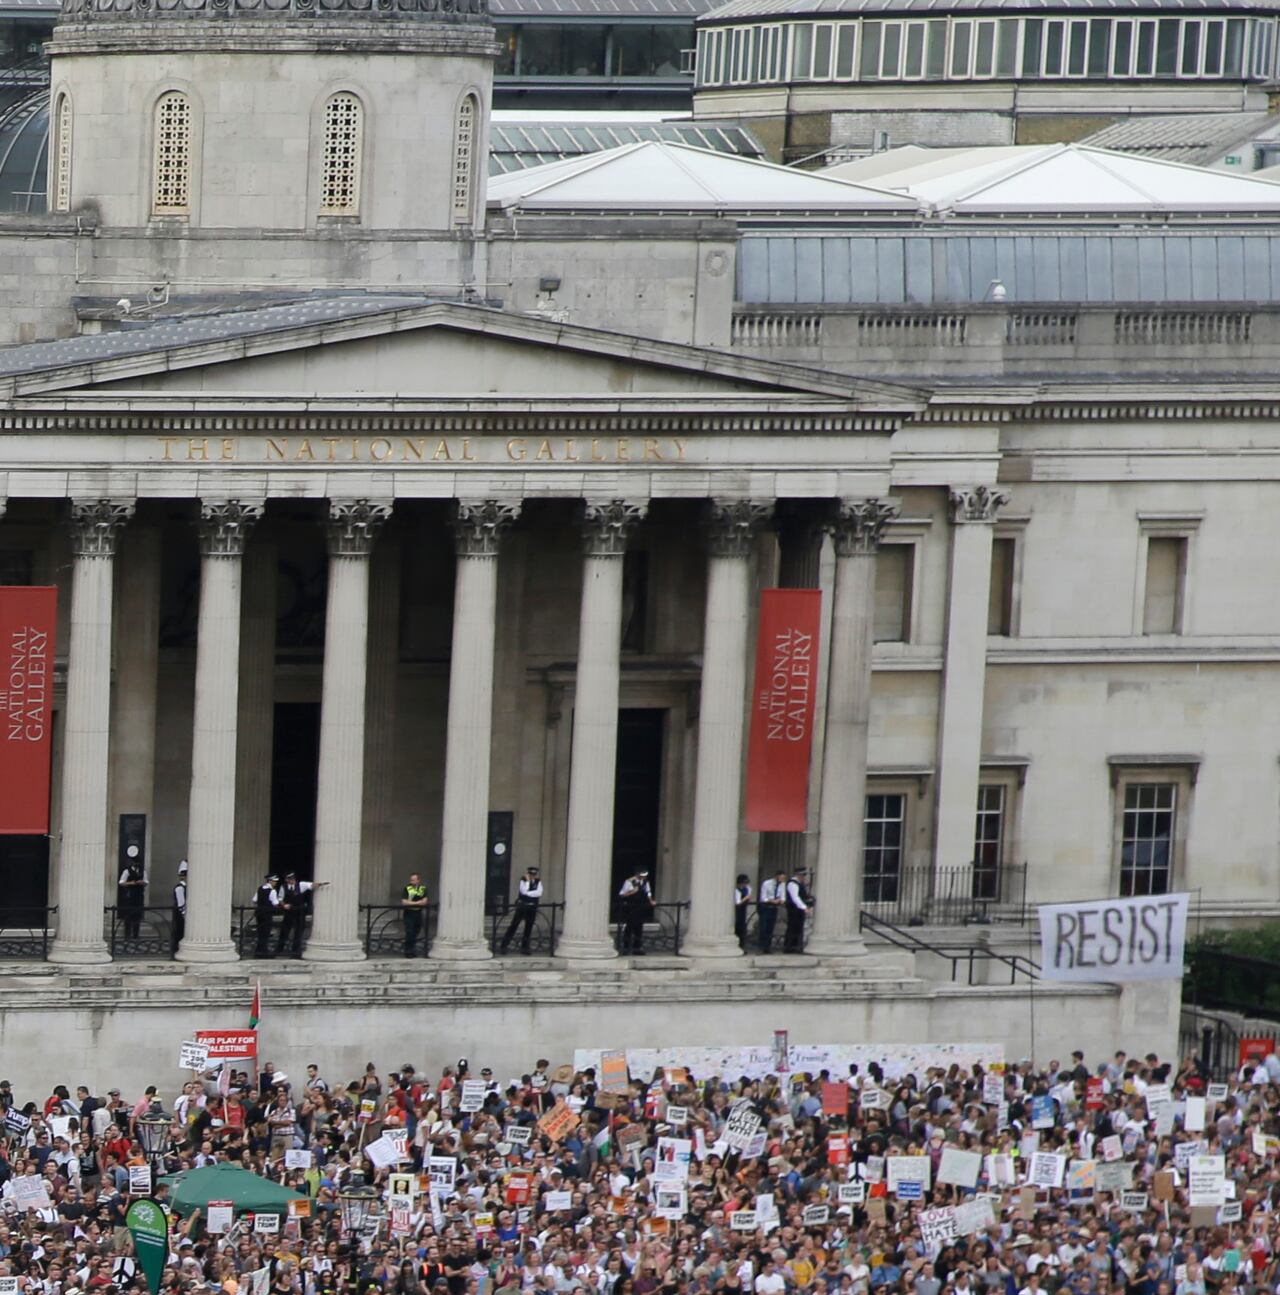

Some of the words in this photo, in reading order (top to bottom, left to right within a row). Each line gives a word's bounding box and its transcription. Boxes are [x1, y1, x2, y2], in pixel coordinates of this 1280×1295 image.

[157, 438, 238, 461] THE
[265, 438, 477, 461] NATIONAL
[505, 438, 689, 462] GALLERY
[7, 627, 28, 741] NATIONAL
[25, 627, 48, 742] GALLERY
[767, 628, 793, 741] NATIONAL
[785, 629, 813, 742] GALLERY
[1054, 900, 1180, 969] RESIST
[198, 1037, 218, 1045] FAIR
[7, 1107, 30, 1126] Trump
[727, 1125, 751, 1137] WITH
[918, 1206, 954, 1224] LOVE
[924, 1225, 958, 1242] HATE
